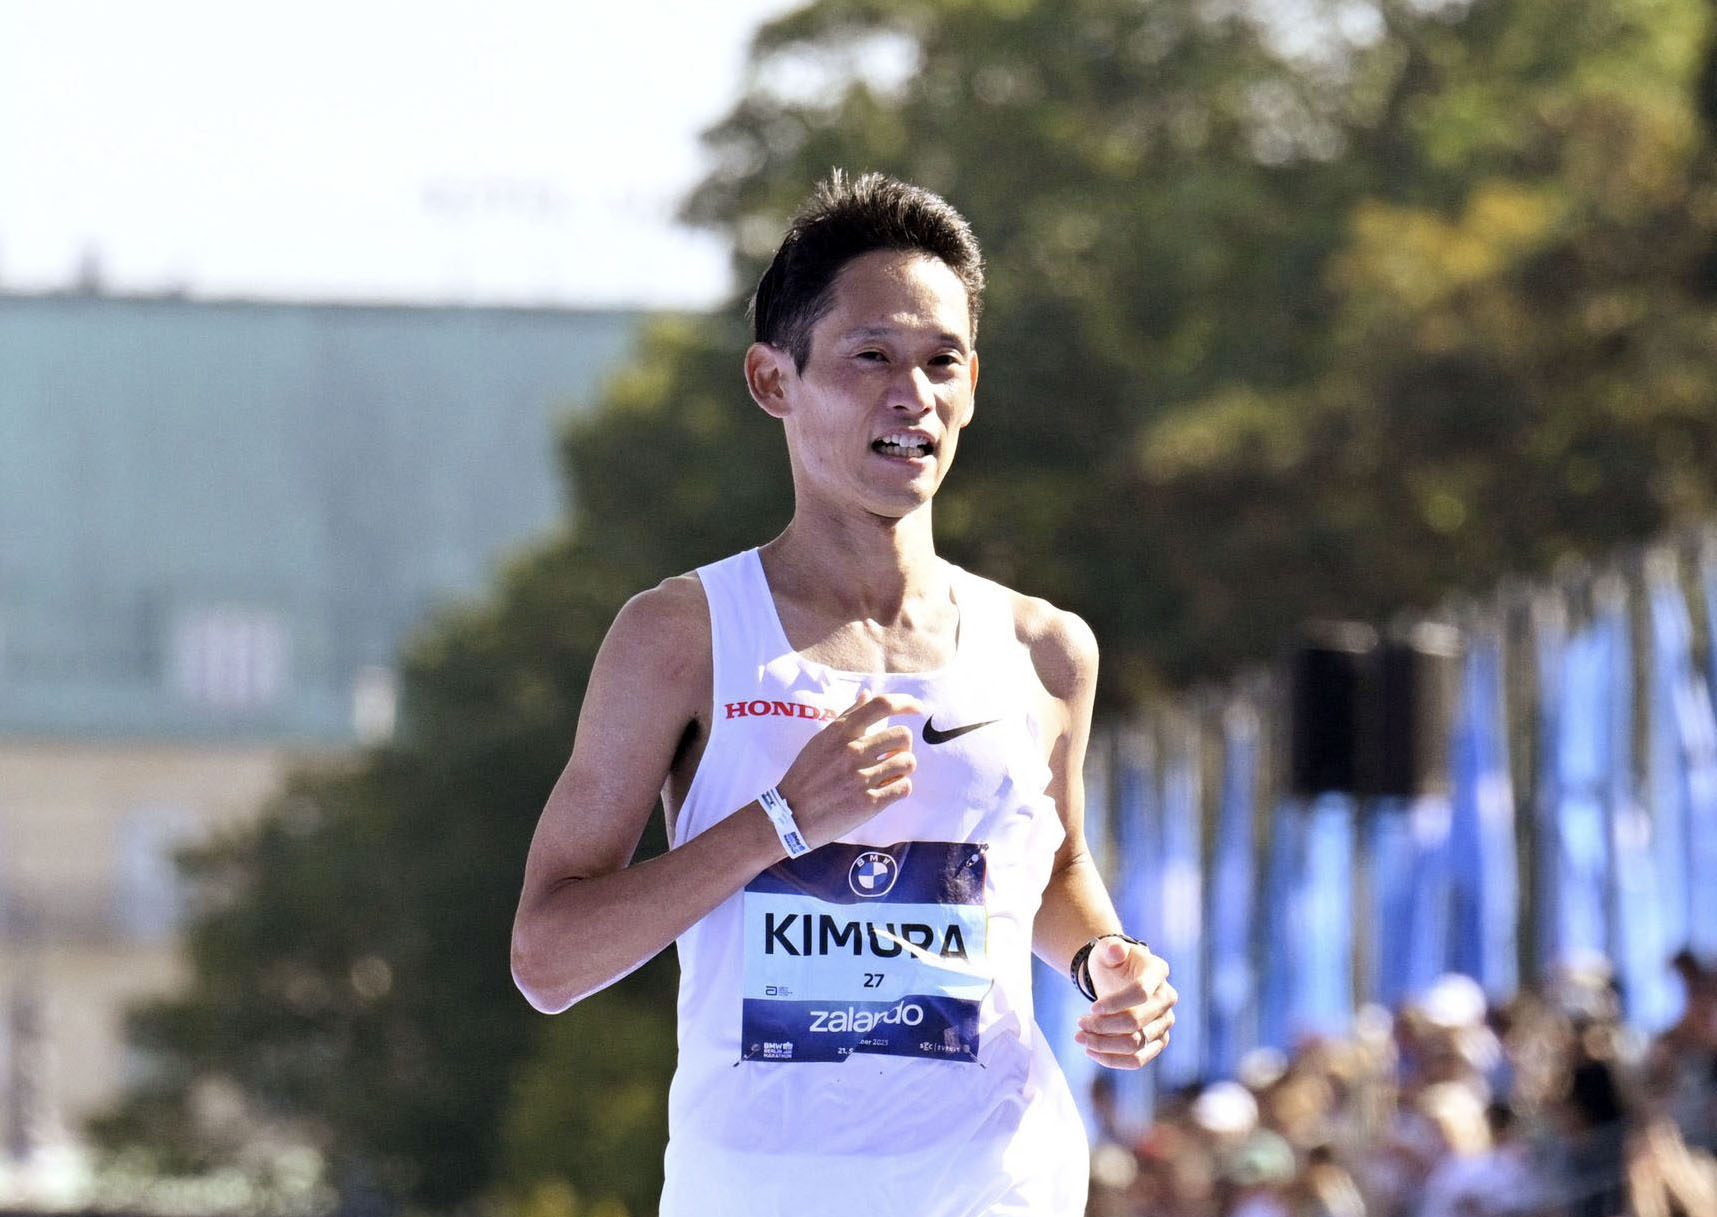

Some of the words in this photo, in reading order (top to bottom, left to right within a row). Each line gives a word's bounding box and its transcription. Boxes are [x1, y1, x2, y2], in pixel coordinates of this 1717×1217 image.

[724, 700, 838, 721] HONDA
[857, 854, 891, 867] BMW
[765, 912, 968, 960] KIMURA
[864, 973, 885, 988] 27
[809, 1000, 924, 1032] zalando
